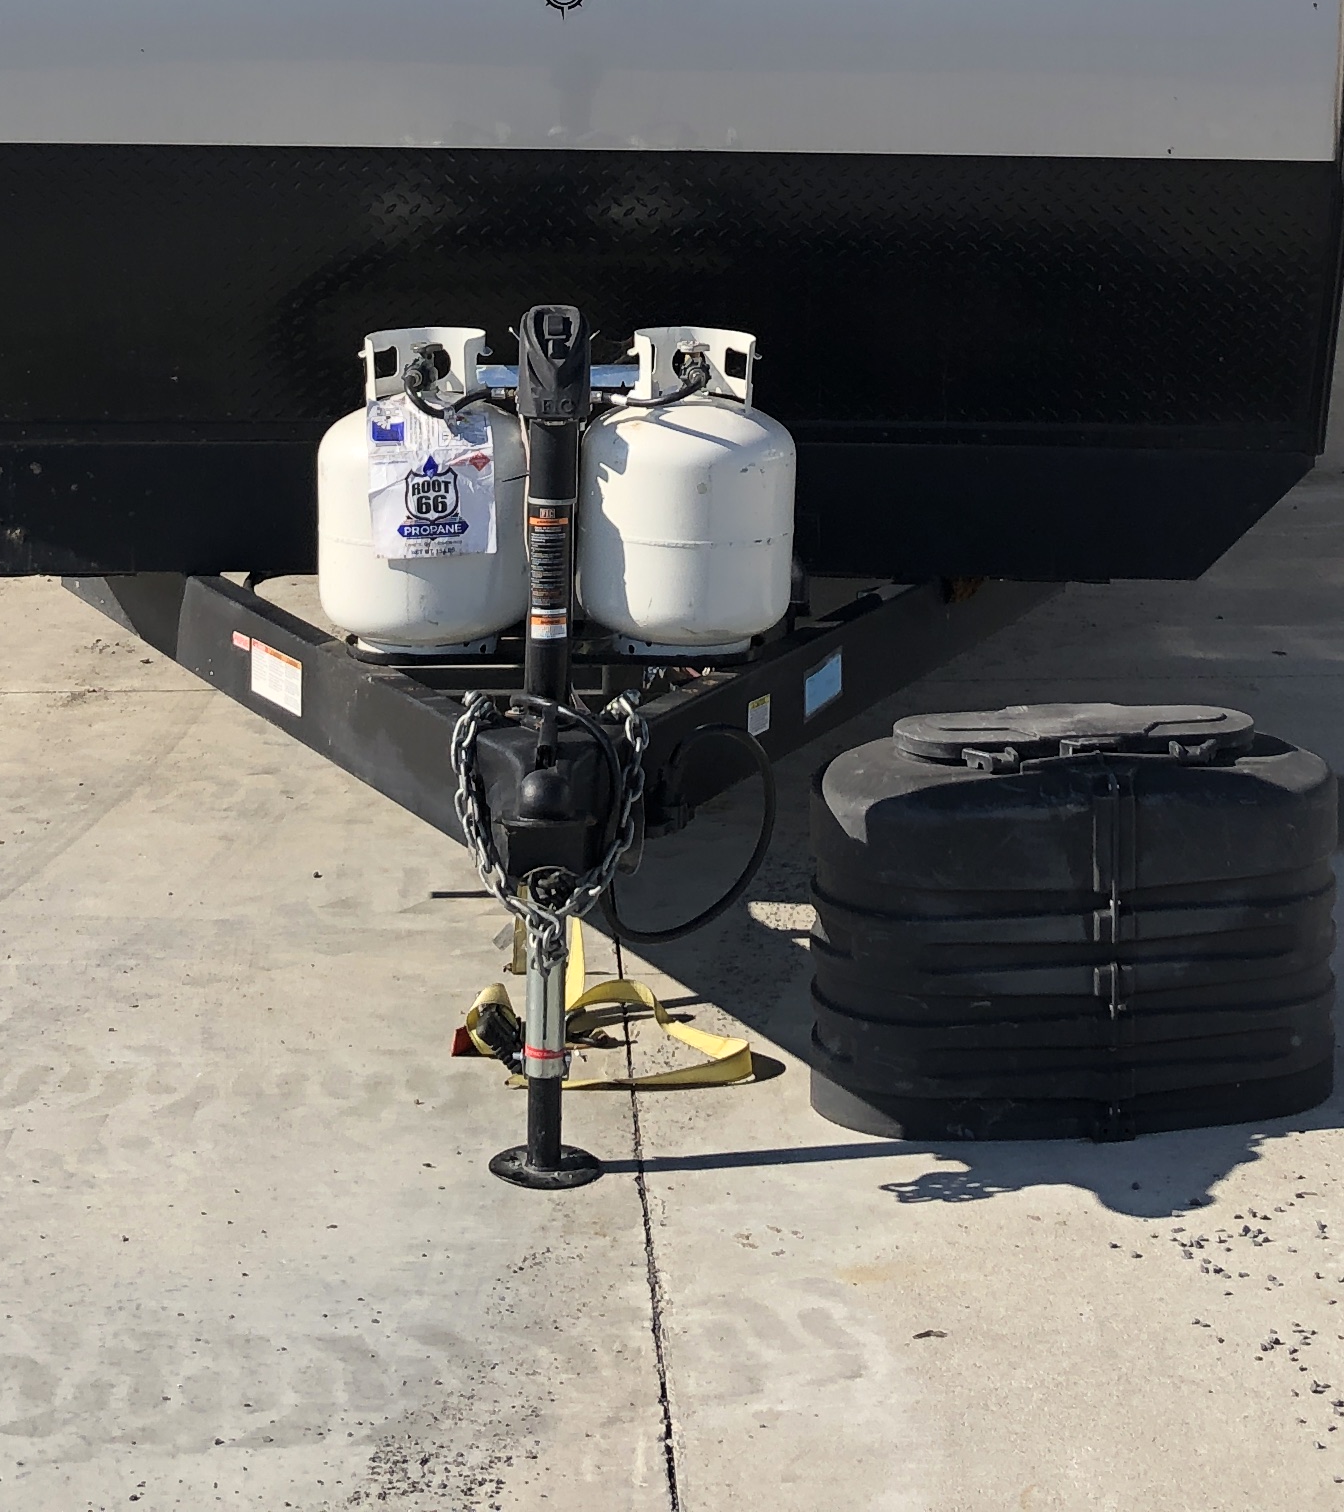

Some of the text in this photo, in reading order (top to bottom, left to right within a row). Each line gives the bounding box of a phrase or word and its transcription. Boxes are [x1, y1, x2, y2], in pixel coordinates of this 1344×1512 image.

[411, 479, 452, 497] ROOT
[416, 494, 448, 515] 66
[403, 523, 463, 537] PROPANE
